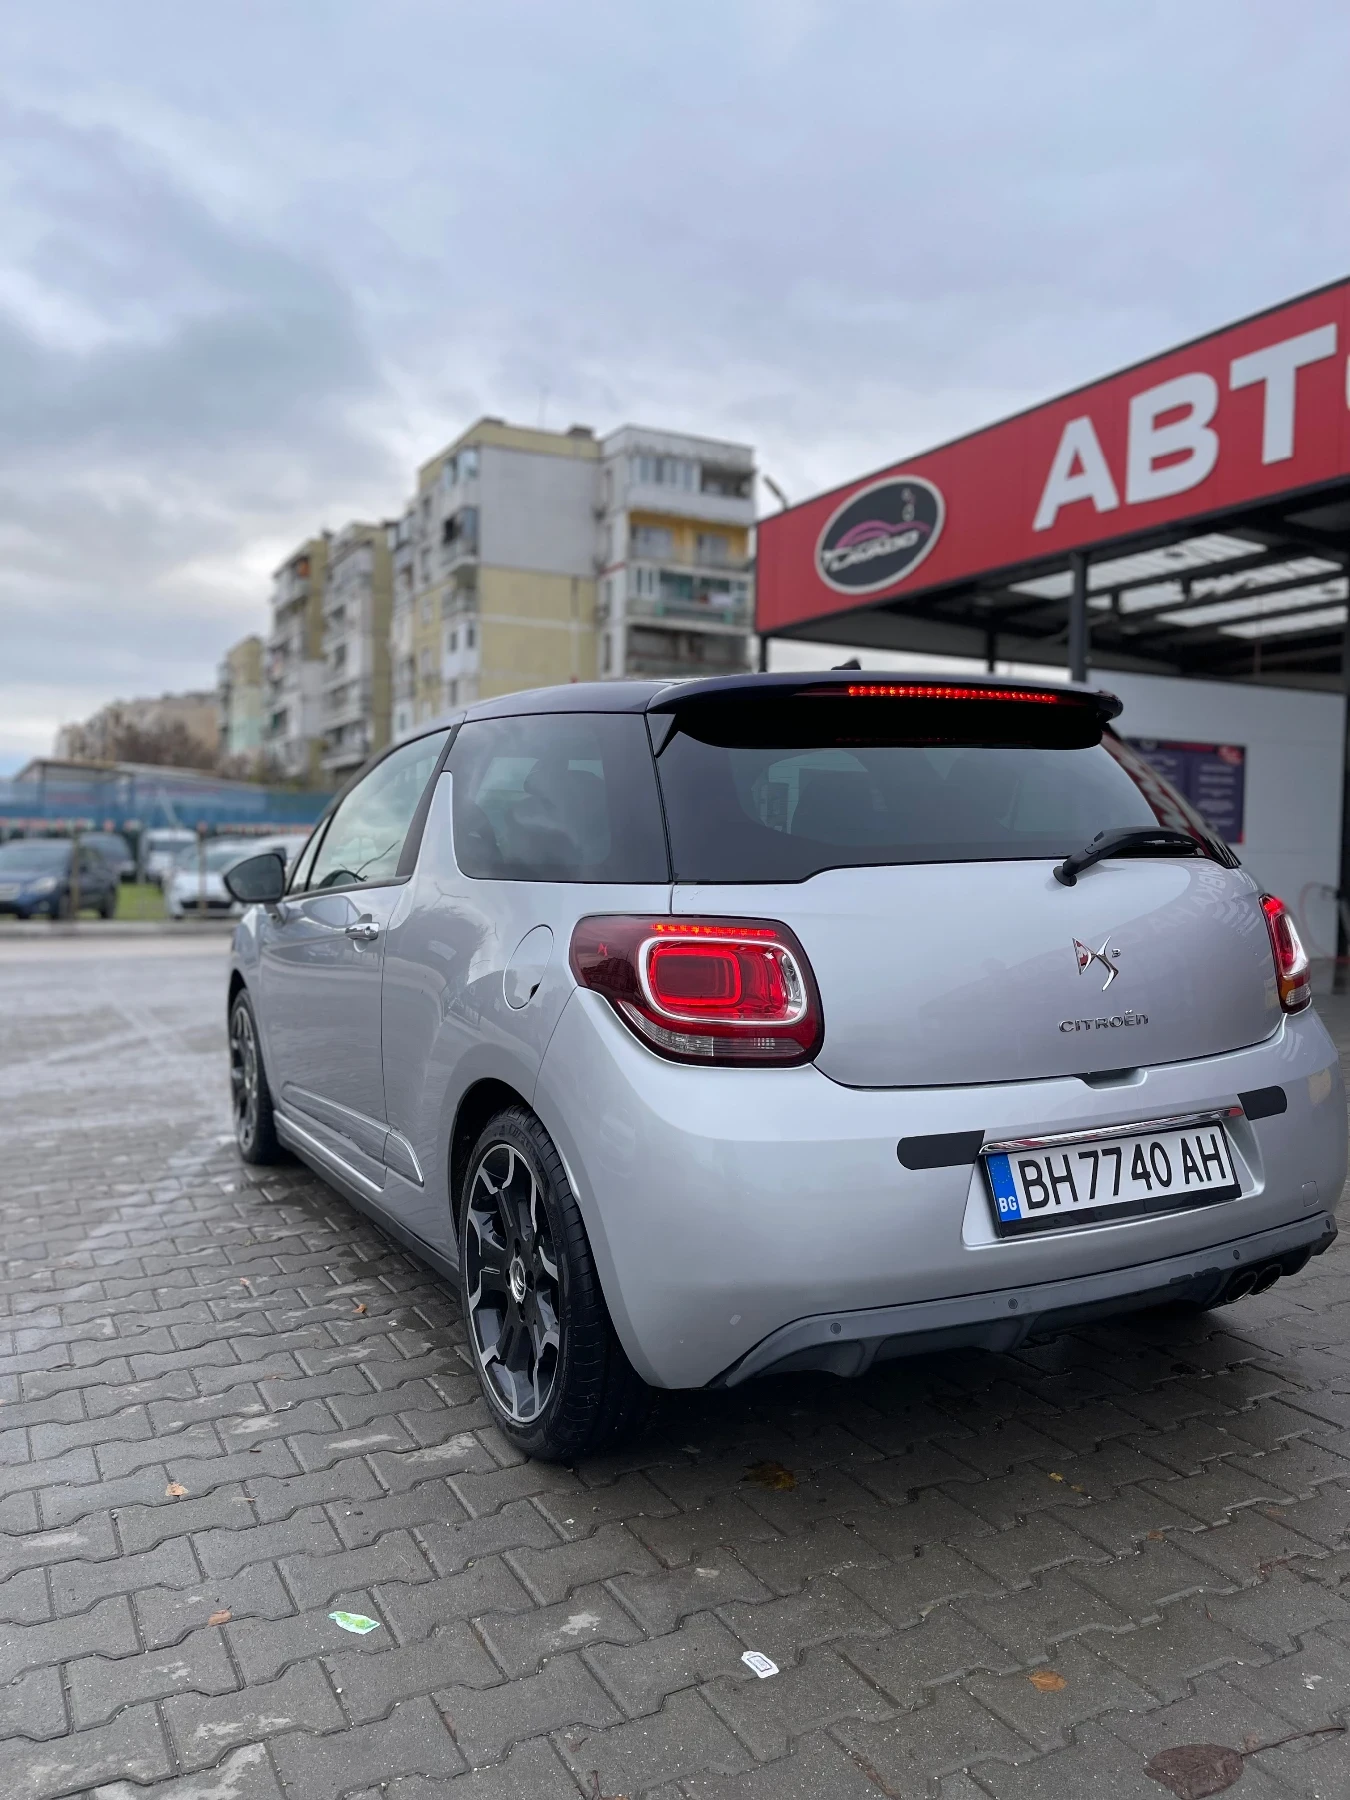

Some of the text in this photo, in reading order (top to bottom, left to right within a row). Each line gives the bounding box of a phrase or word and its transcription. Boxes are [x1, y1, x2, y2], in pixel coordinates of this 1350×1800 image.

[1032, 322, 1350, 532] АВТ
[1180, 1133, 1227, 1185] AH
[999, 1196, 1018, 1213] BG
